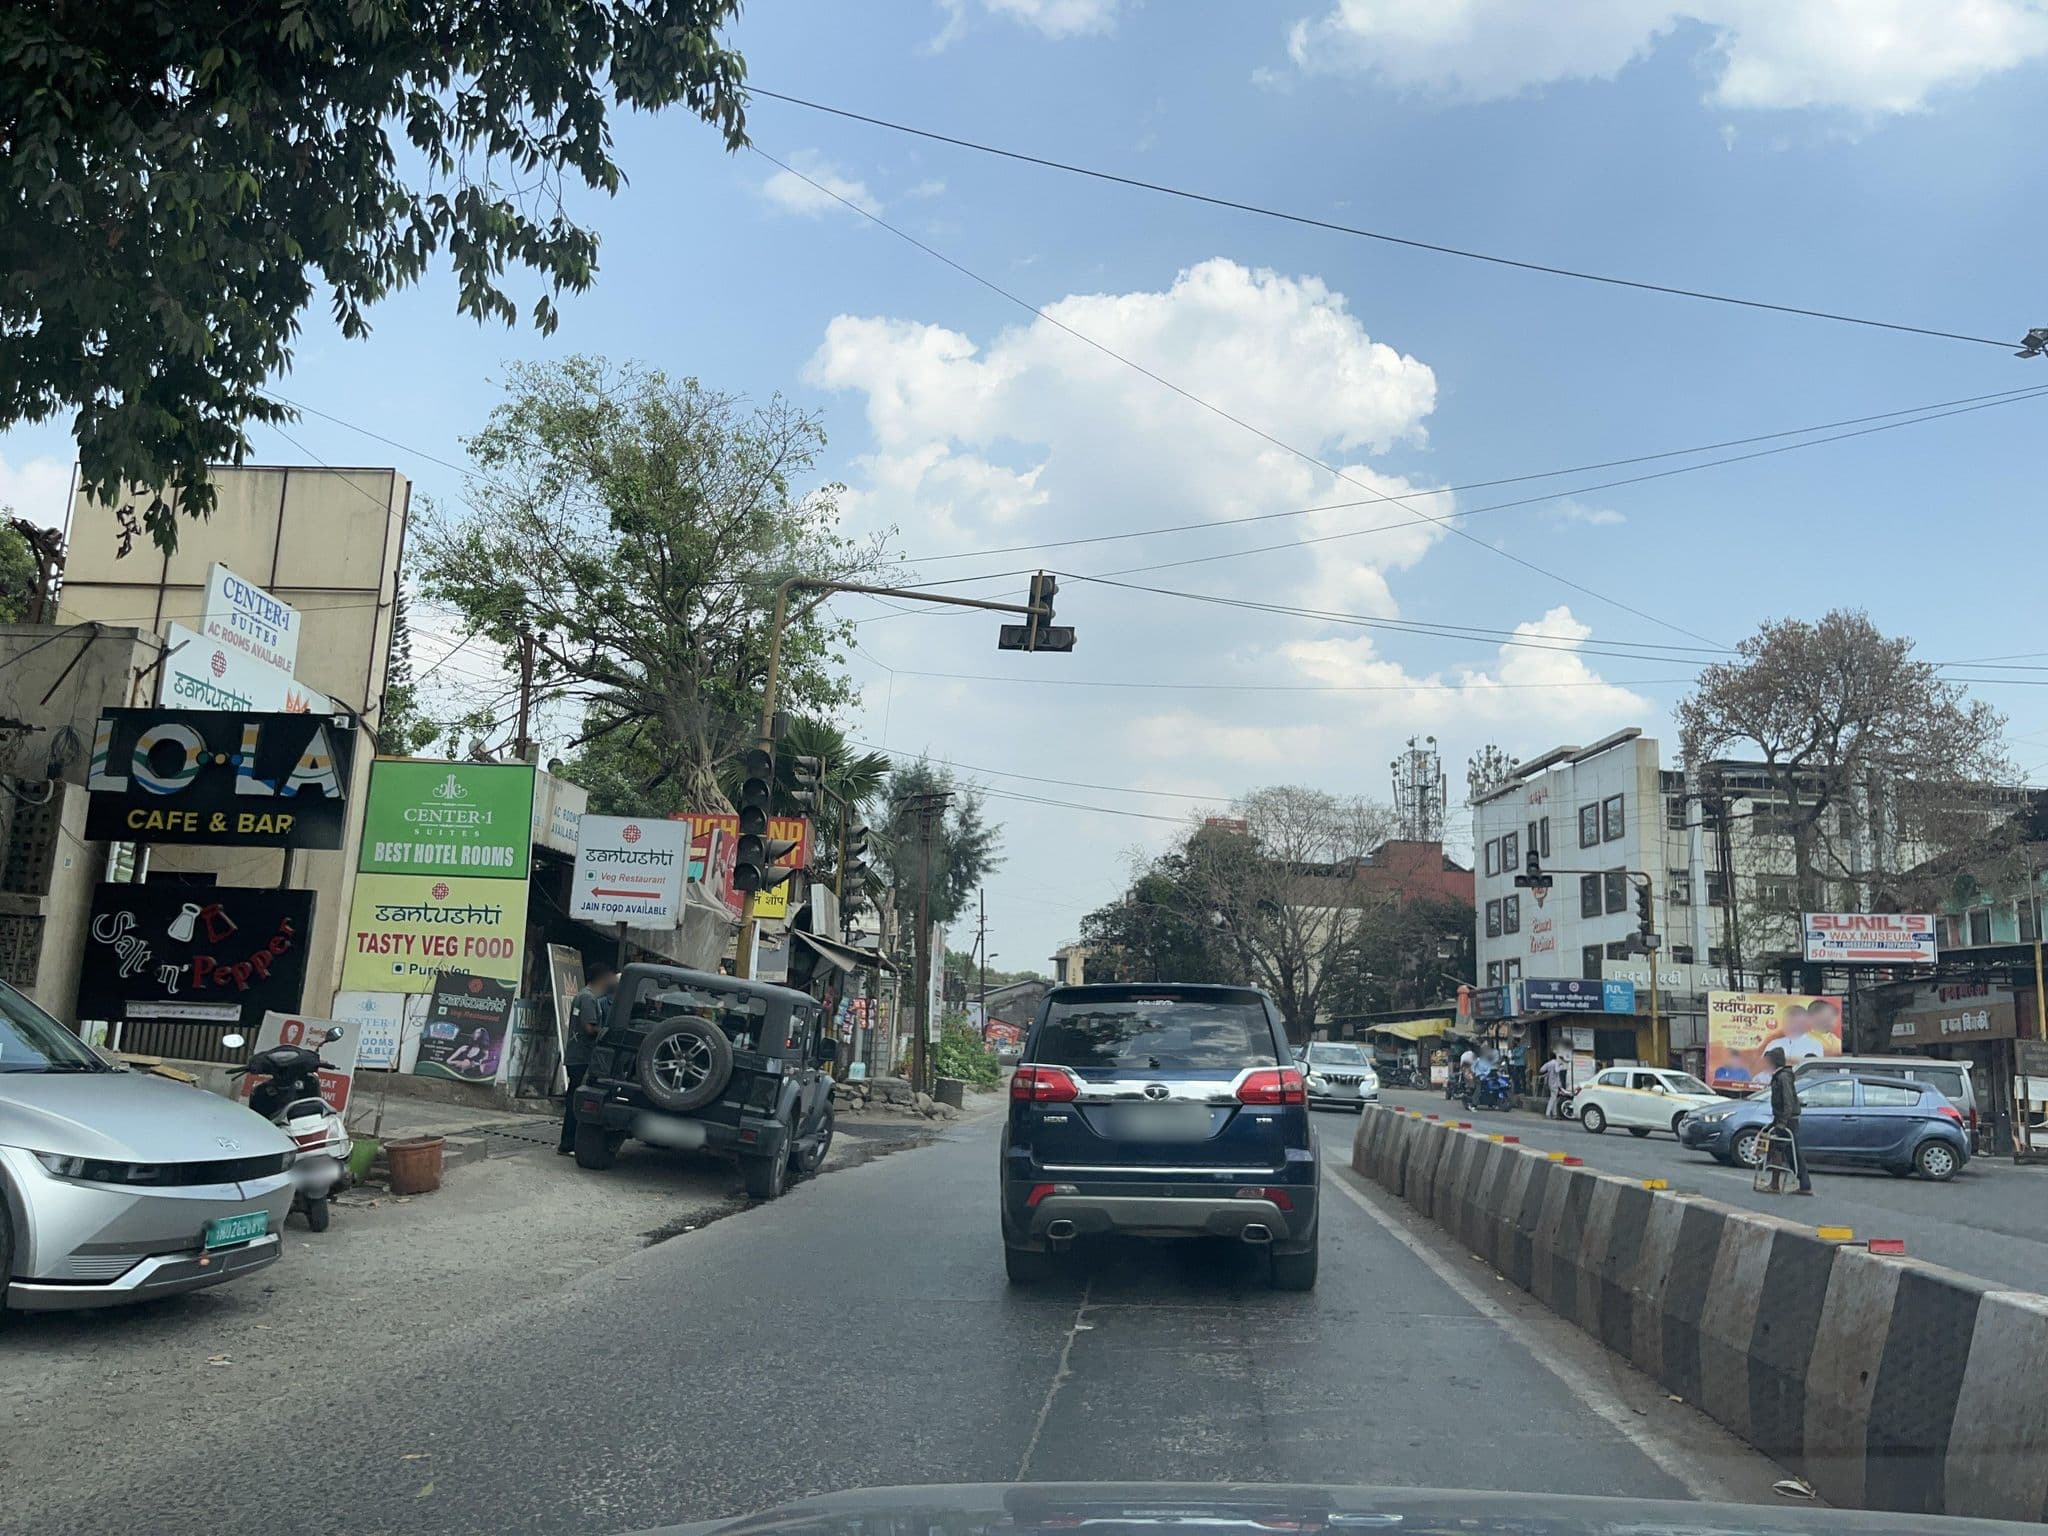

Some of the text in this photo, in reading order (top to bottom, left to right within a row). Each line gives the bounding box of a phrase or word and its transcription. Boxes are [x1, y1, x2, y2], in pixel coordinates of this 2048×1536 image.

[231, 612, 277, 647] SUITES
[208, 621, 292, 672] AC ROOMS AVAILABLE
[174, 670, 253, 712] santushti
[127, 809, 294, 834] CAFE & BAR
[414, 828, 480, 837] SUITES
[374, 842, 514, 867] BEST HOTEL ROOMS
[586, 846, 674, 866] santushti
[601, 872, 666, 884] Veg Restaurant
[375, 901, 502, 925] santushti
[581, 901, 667, 915] JAIN FOOD AVAILABLE
[1812, 915, 1926, 931] SUNIL'S
[357, 933, 514, 959] TASTY VEG FOOD
[1830, 932, 1857, 941] WAX
[1860, 932, 1912, 942] MUSEUM
[92, 911, 152, 978] Salt
[192, 917, 295, 992] Pepper
[1812, 949, 1826, 959] 50
[1712, 998, 1775, 1015] संदीपभाऊ
[362, 1038, 394, 1047] OOMS
